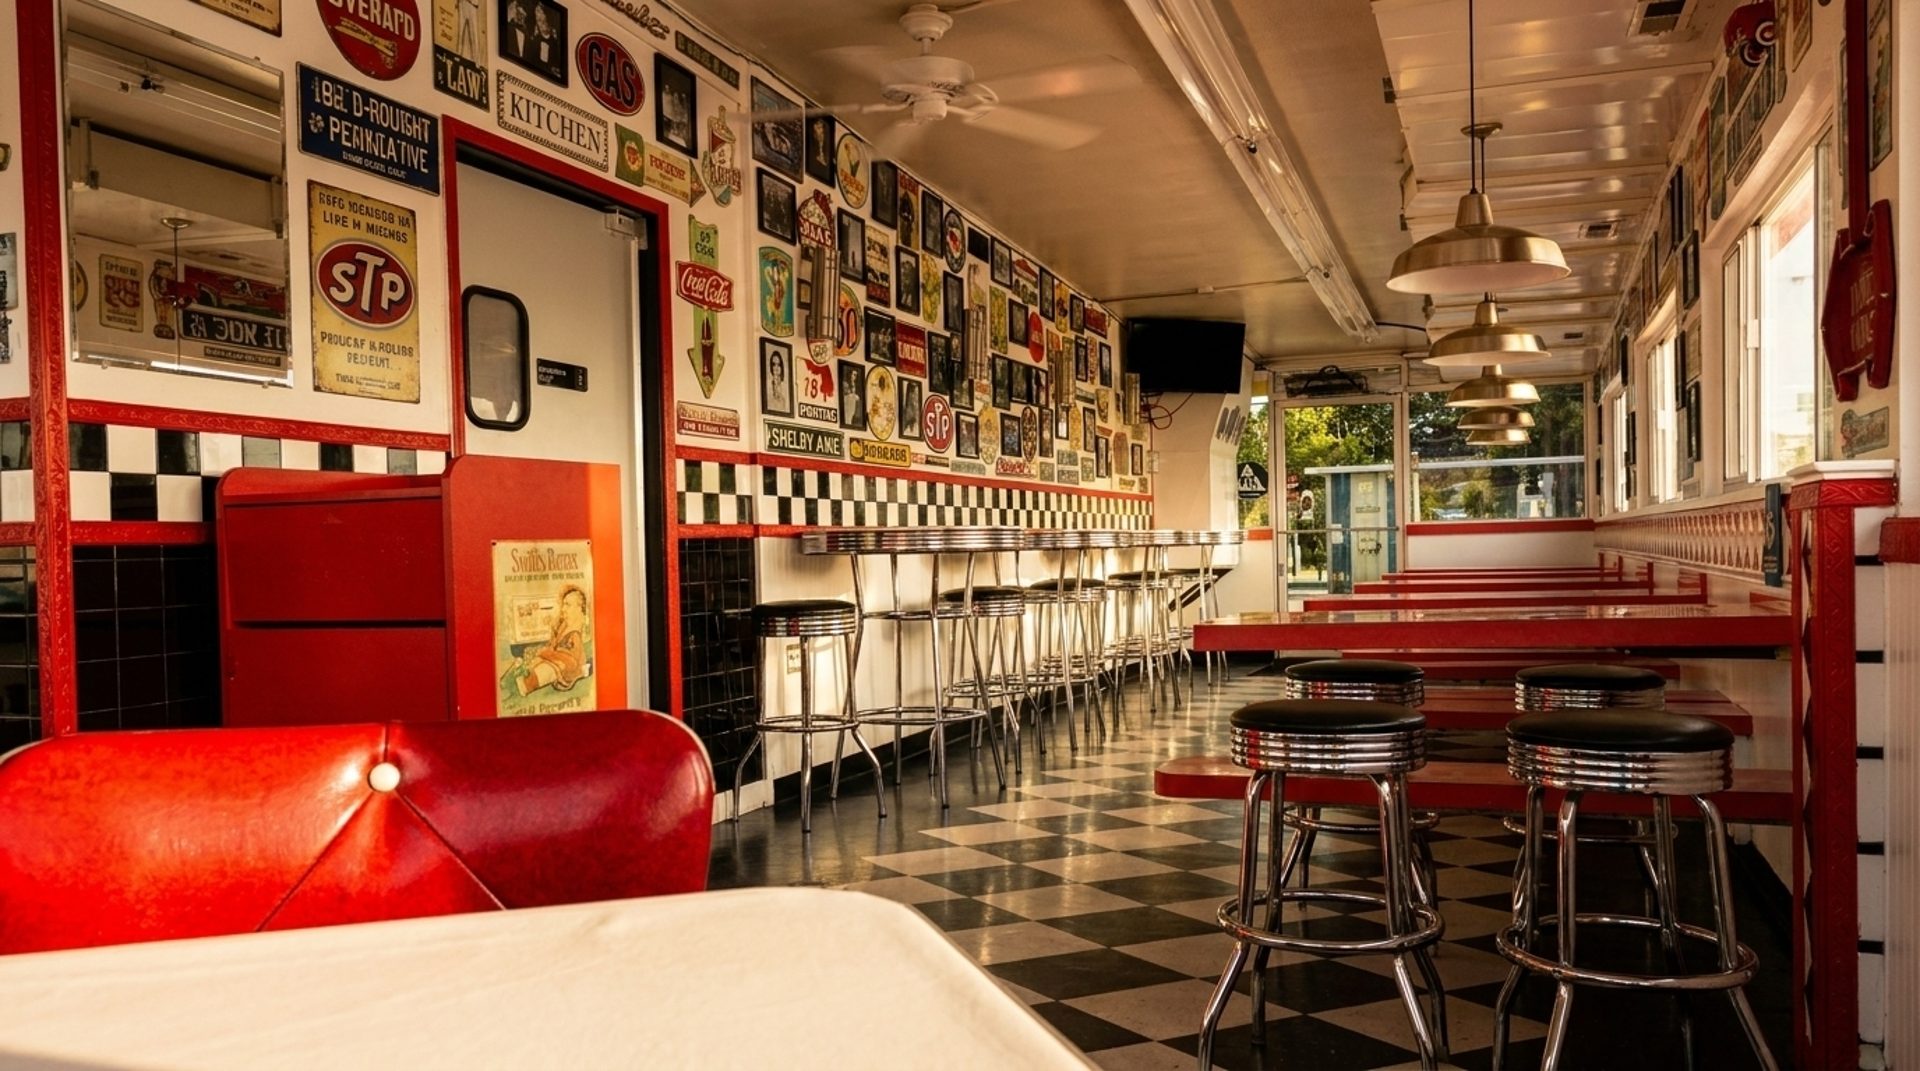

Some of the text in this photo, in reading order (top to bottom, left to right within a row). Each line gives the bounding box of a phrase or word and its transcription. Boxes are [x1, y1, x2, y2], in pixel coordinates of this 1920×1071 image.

[445, 60, 481, 101] LAW
[585, 41, 637, 108] GAS
[509, 91, 602, 155] KITCHEN
[329, 250, 407, 315] STP
[772, 427, 814, 451] SHELBY
